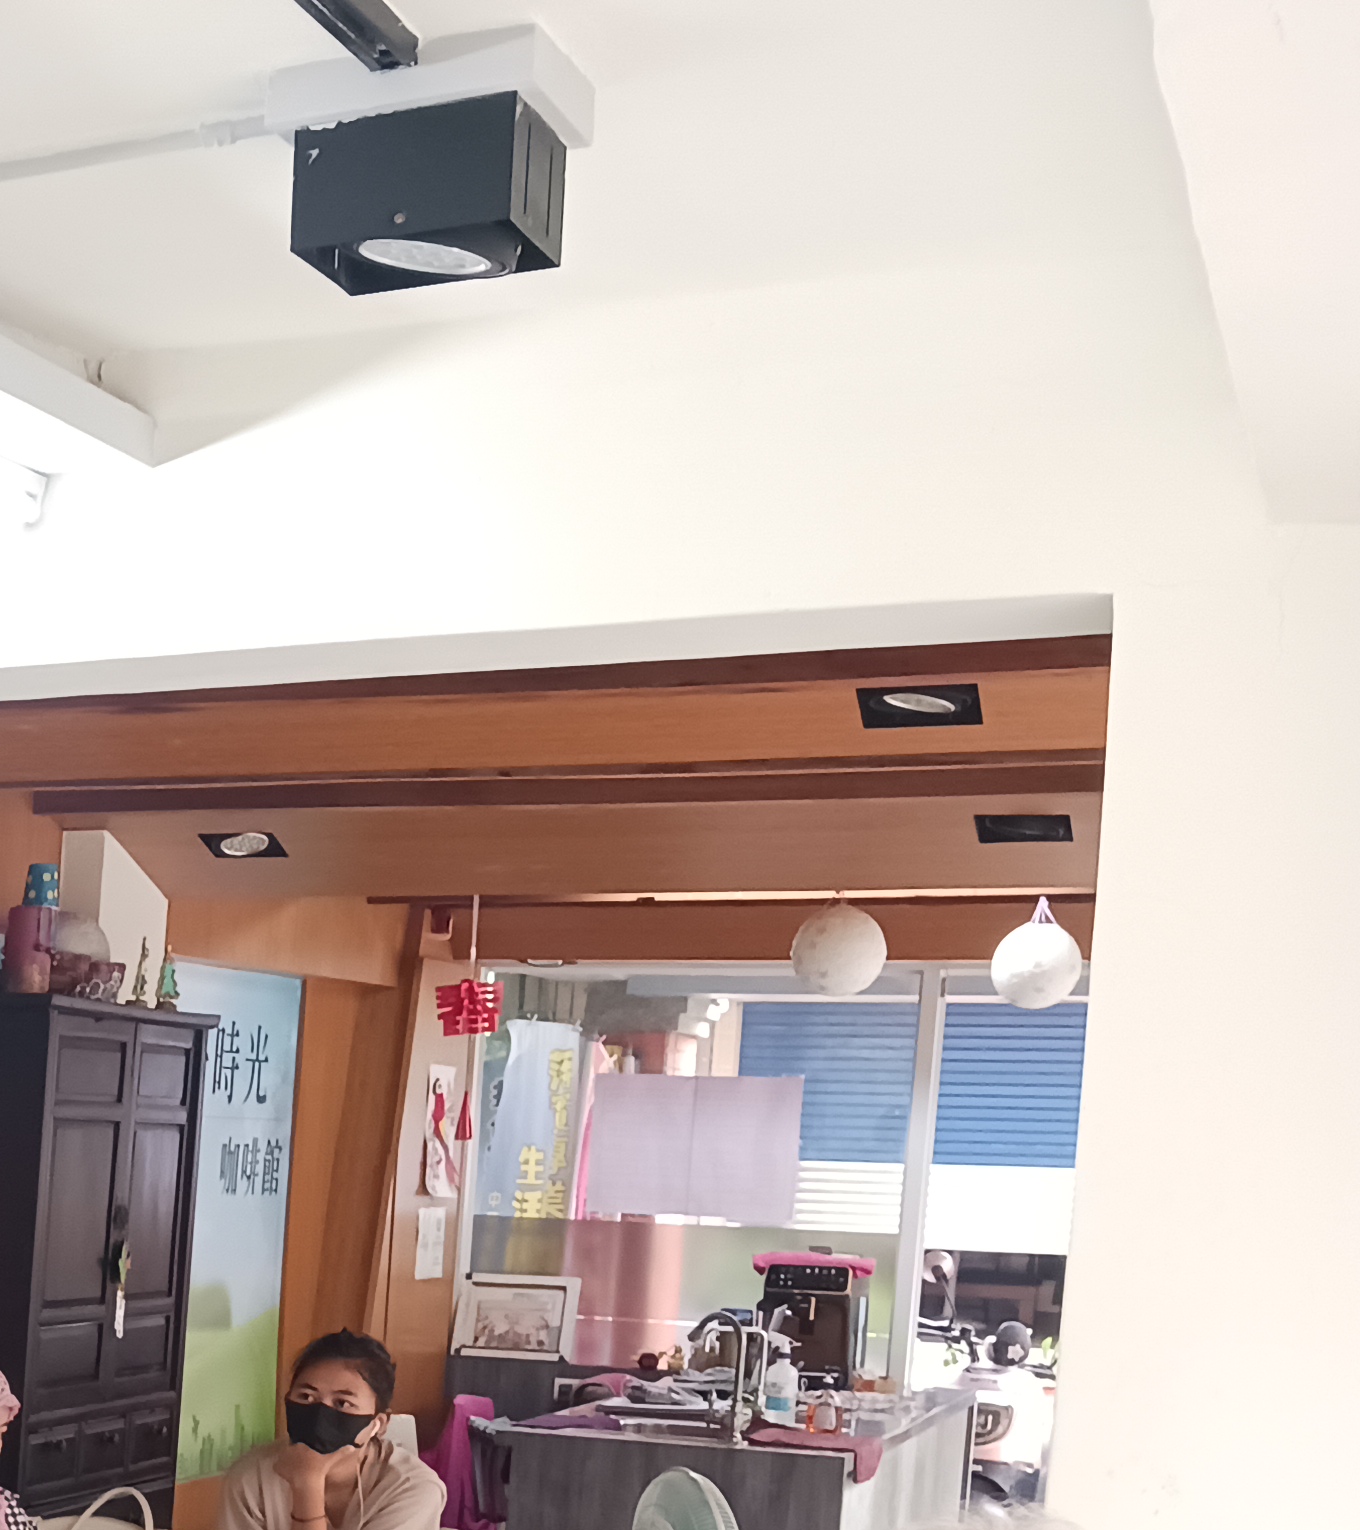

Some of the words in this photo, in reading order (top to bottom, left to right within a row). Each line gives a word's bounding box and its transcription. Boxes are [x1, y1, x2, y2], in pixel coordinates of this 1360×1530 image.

[212, 1020, 269, 1105] 時光
[219, 1136, 283, 1197] 咖啡館
